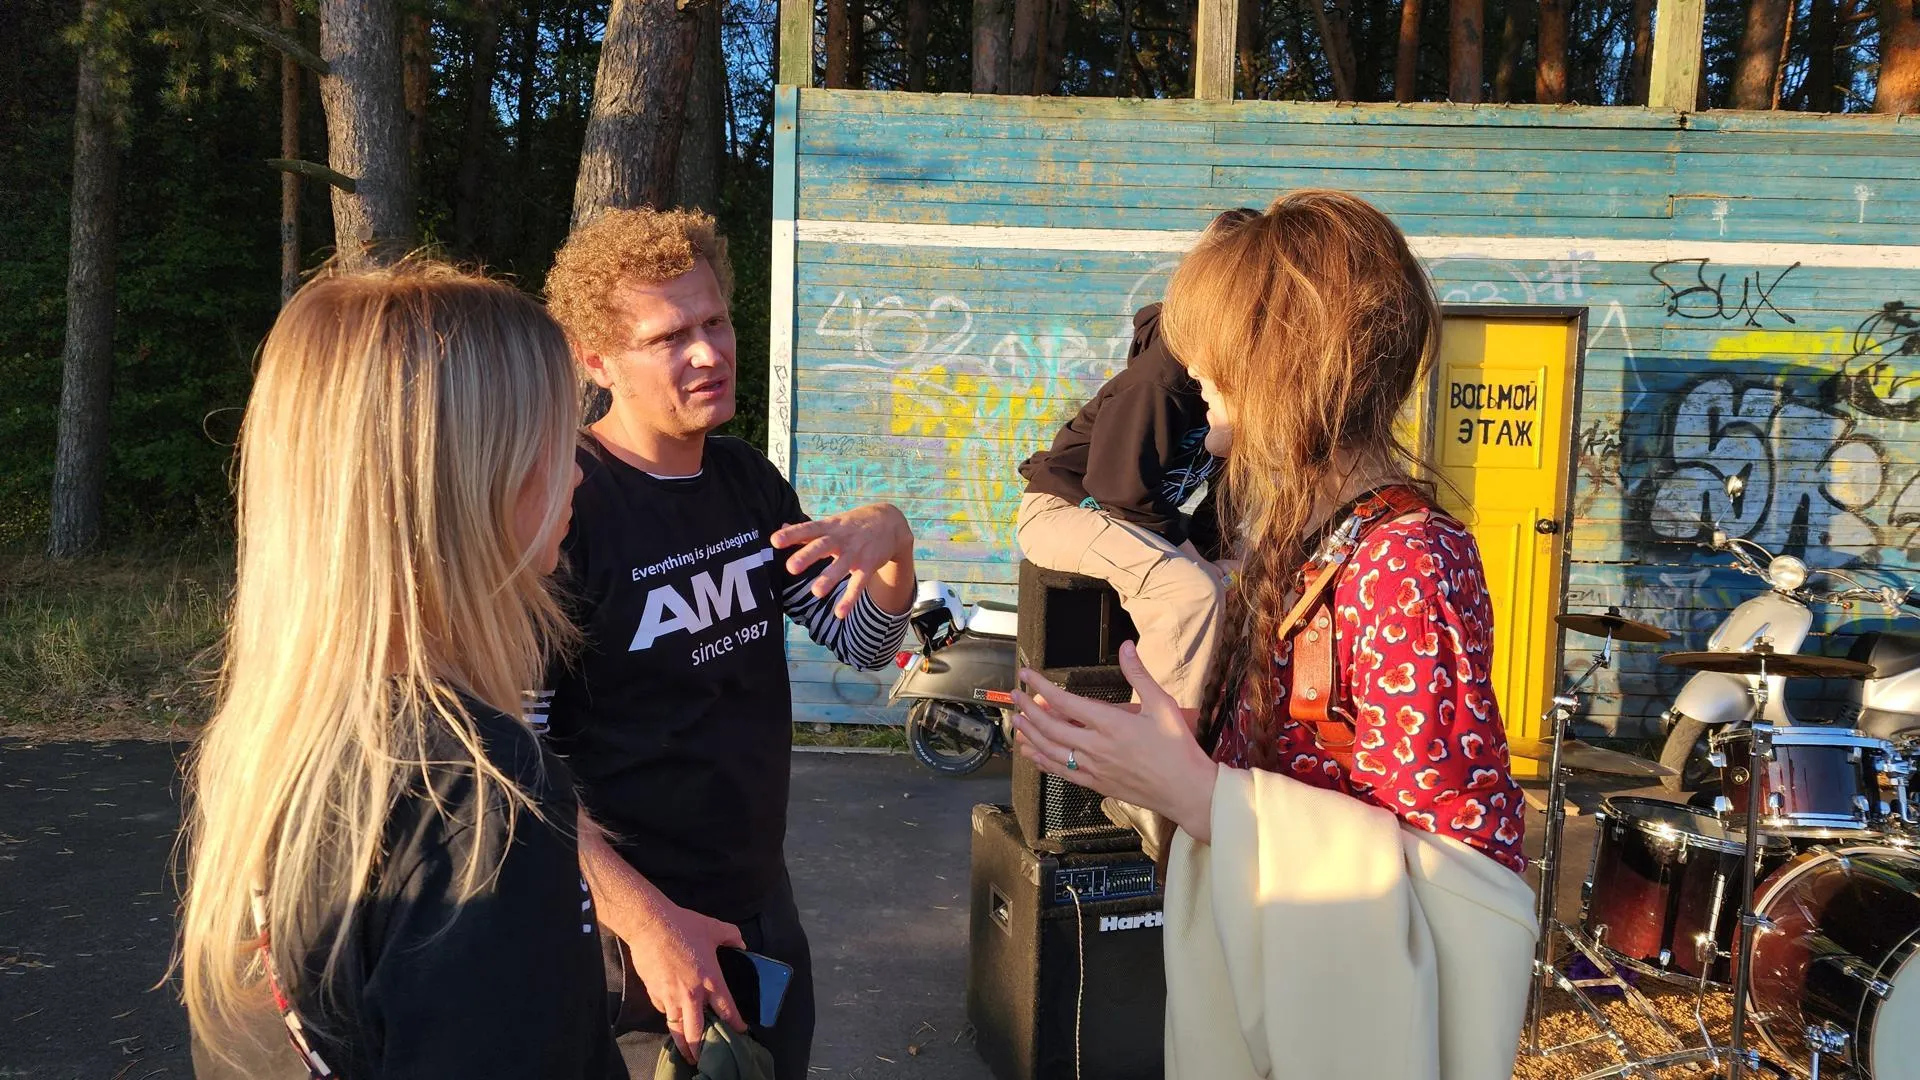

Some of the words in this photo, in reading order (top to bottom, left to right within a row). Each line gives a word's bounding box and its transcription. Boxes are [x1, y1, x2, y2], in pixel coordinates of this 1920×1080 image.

[1450, 381, 1537, 410] ВОСЬМОЙ
[1458, 418, 1533, 446] ЭТАЖ
[631, 553, 695, 581] Everything
[694, 547, 704, 559] is
[705, 541, 726, 559] just
[691, 636, 733, 666] since
[734, 620, 769, 646] 1987
